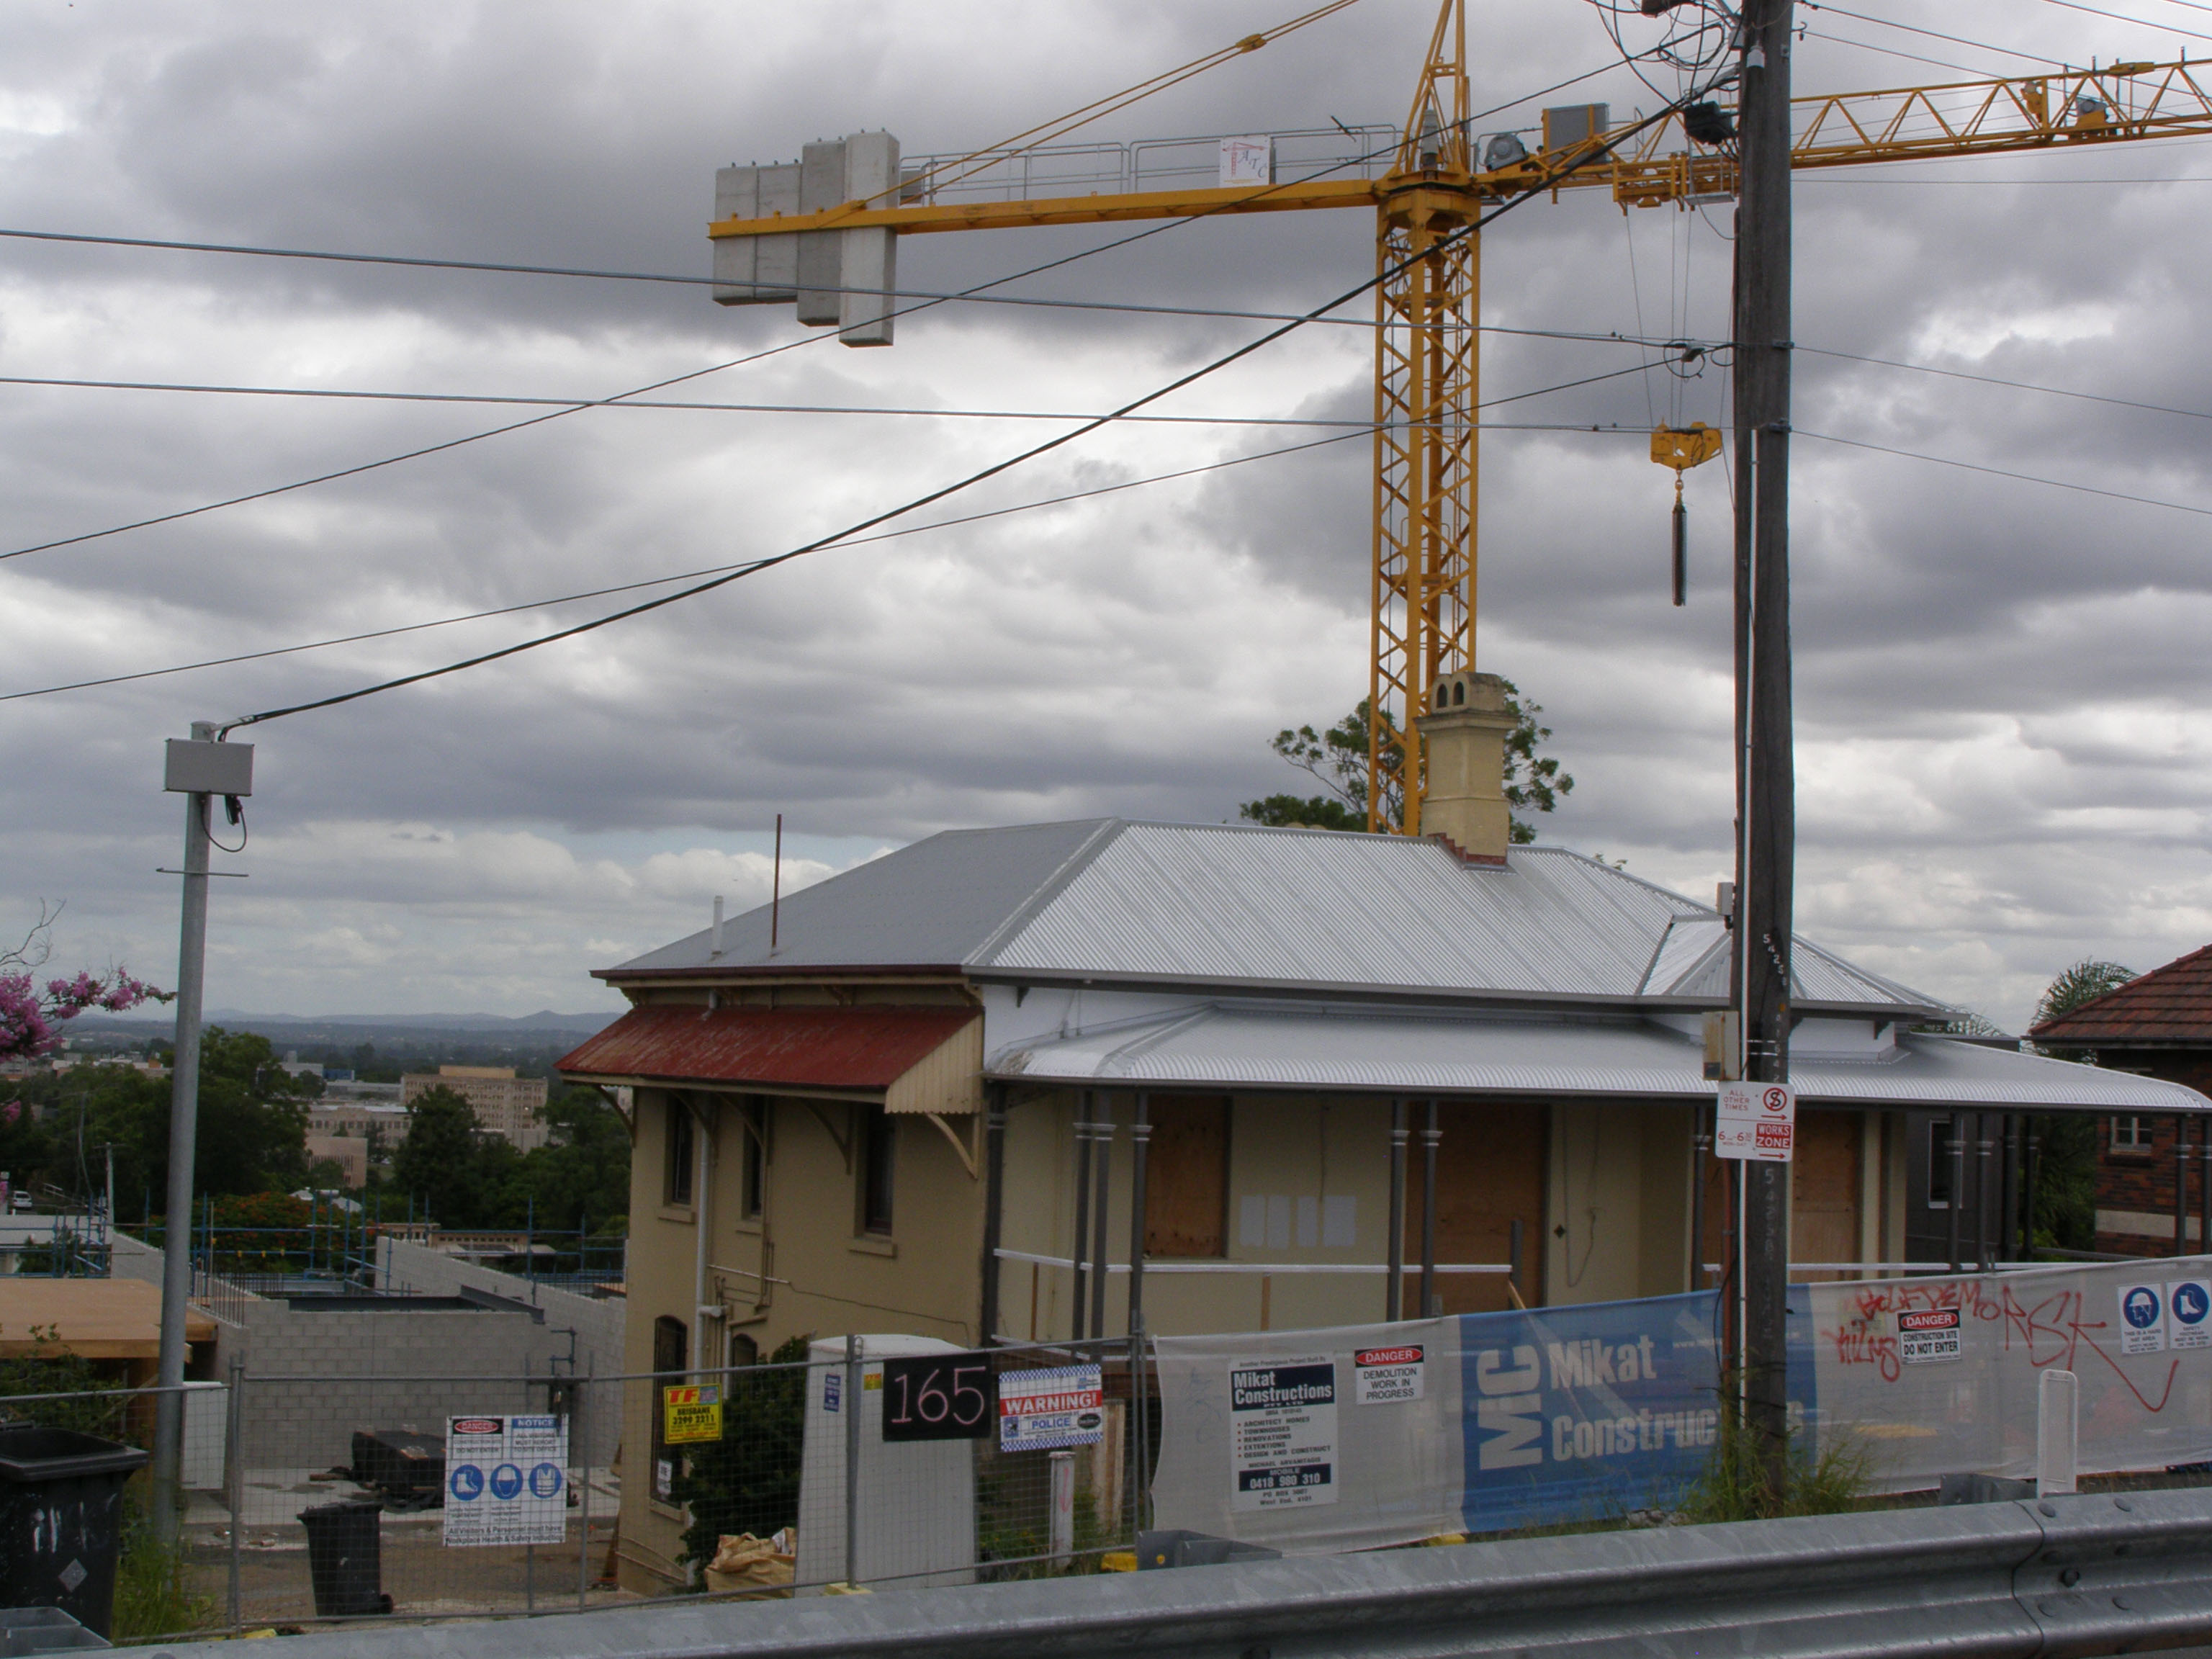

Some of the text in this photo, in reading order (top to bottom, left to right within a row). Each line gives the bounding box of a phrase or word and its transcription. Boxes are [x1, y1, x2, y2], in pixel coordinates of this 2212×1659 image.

[1758, 1124, 1790, 1136] WORKS
[1757, 1136, 1790, 1148] ZONE
[1906, 1314, 1952, 1326] DANGER
[1903, 1330, 1958, 1342] CONSTRUCTION SITE
[1903, 1341, 1959, 1355] DO NOT ENTER
[1364, 1349, 1413, 1363] DANGER
[1547, 1334, 1658, 1390] Mikat
[1233, 1370, 1276, 1389] Mikat
[1363, 1367, 1417, 1380] DEMOLITION
[1371, 1377, 1411, 1389] WORK IN
[891, 1365, 986, 1426] 165
[1234, 1383, 1332, 1405] Constructions
[1366, 1387, 1414, 1401] PROGRESS
[1005, 1392, 1097, 1415] WARNING!
[462, 1421, 493, 1430] DANGER
[1031, 1417, 1071, 1430] POLICE
[1244, 1418, 1282, 1427] ARCHITECT
[1244, 1426, 1291, 1435] TOWNHOUSES
[1244, 1433, 1292, 1443] RENOVATIONS
[1244, 1450, 1269, 1459] DESIGN
[1291, 1444, 1331, 1455] CONSTRUCT
[1269, 1467, 1301, 1477] MOBILE
[1249, 1476, 1274, 1490] 0418
[1302, 1472, 1321, 1485] 310
